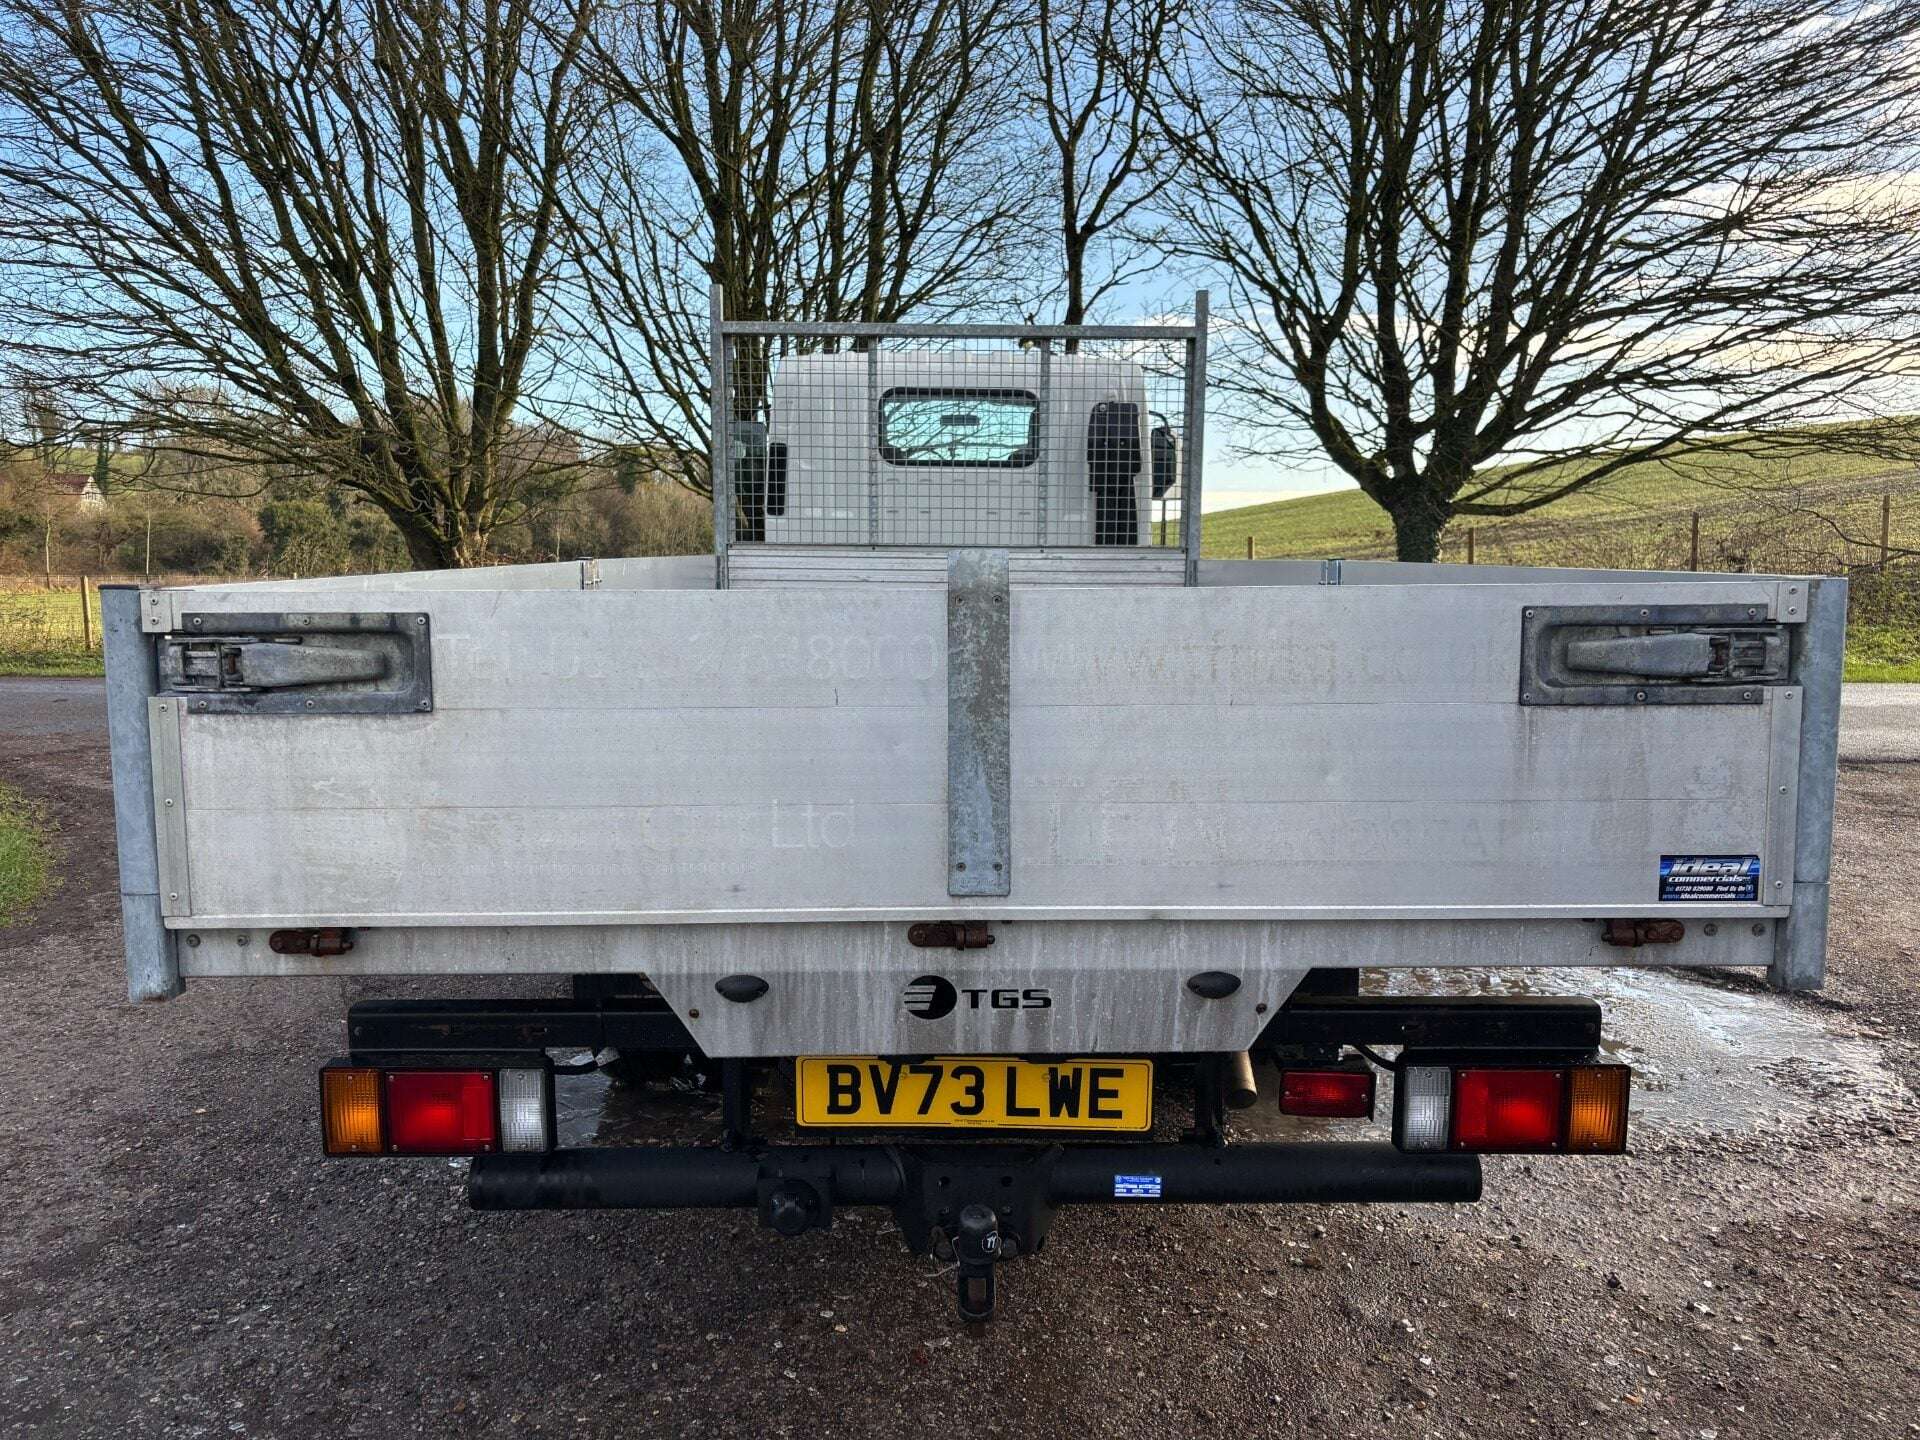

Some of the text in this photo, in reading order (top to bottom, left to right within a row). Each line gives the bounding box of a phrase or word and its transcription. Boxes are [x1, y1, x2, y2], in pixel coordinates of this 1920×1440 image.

[1669, 857, 1753, 875] ideal
[1668, 875, 1743, 883] commercials
[961, 989, 1052, 1009] TGS
[826, 1064, 1125, 1119] BV73 LWE
